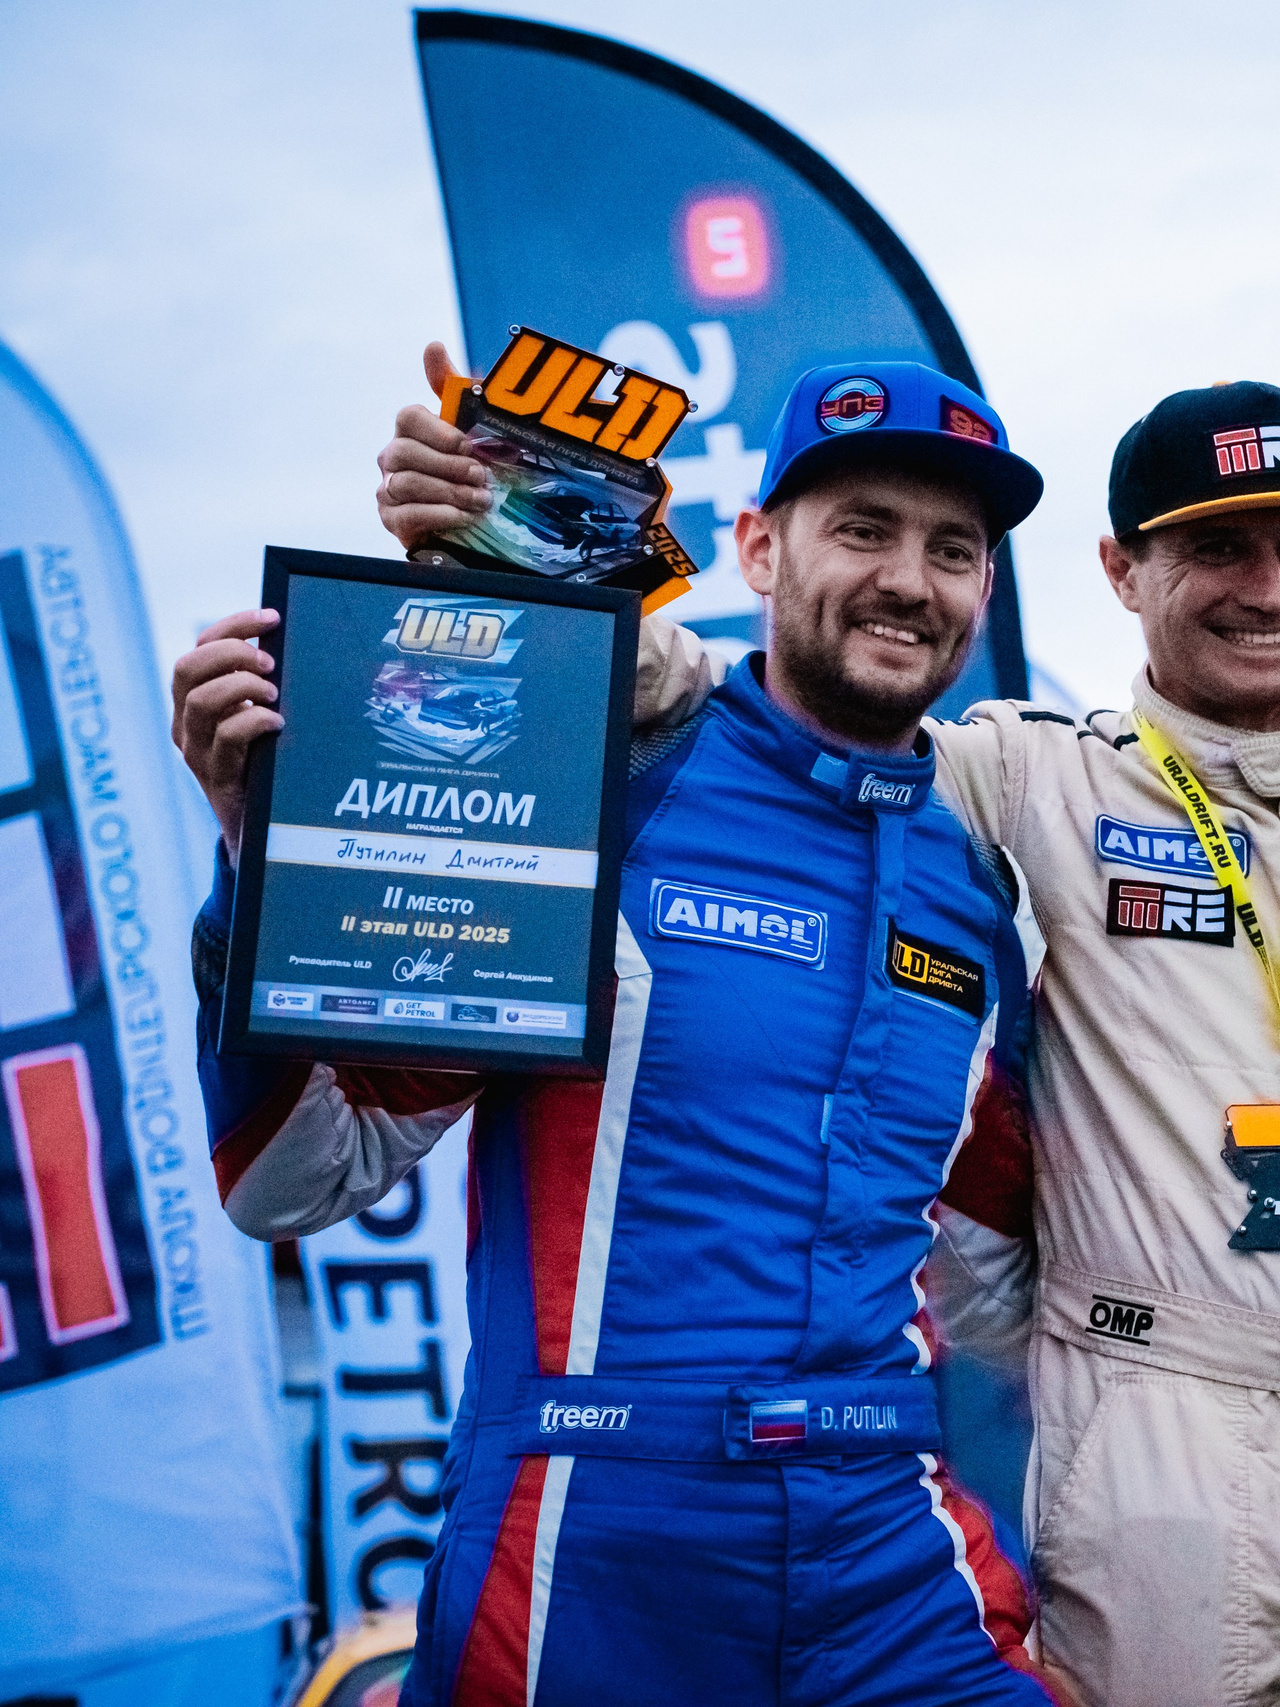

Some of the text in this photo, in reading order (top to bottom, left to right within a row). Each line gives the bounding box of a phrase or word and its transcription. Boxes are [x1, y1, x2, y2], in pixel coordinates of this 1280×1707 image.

[485, 332, 689, 460] ULD
[646, 524, 694, 575] 2025
[399, 604, 504, 659] ULD
[335, 778, 536, 827] ДИПЛОМ
[858, 773, 912, 805] freem
[1162, 755, 1232, 869] URALDRIFT.RU
[406, 823, 463, 834] НАГРАЖДАЕТСЯ
[445, 852, 539, 872] Дмитрий
[1104, 829, 1209, 867] AIMO
[407, 894, 475, 914] МЕСТО
[359, 919, 407, 937] этап
[413, 920, 453, 939] ULD
[458, 924, 511, 944] 2025
[663, 897, 814, 950] AIMOL
[1236, 902, 1265, 948] ULD
[288, 955, 373, 970] Руководитель ULD
[473, 969, 505, 982] Сергей
[928, 967, 953, 980] ЛИГА
[929, 958, 979, 982] УРАЛЬСКАЯ
[927, 976, 965, 993] ДРИФТА
[405, 1002, 422, 1010] GET
[405, 1009, 436, 1018] PETROL
[1089, 1302, 1154, 1337] OMP
[324, 1163, 446, 1610] PETRO
[539, 1400, 630, 1433] freem
[820, 1405, 899, 1431] D. PUTILIN
